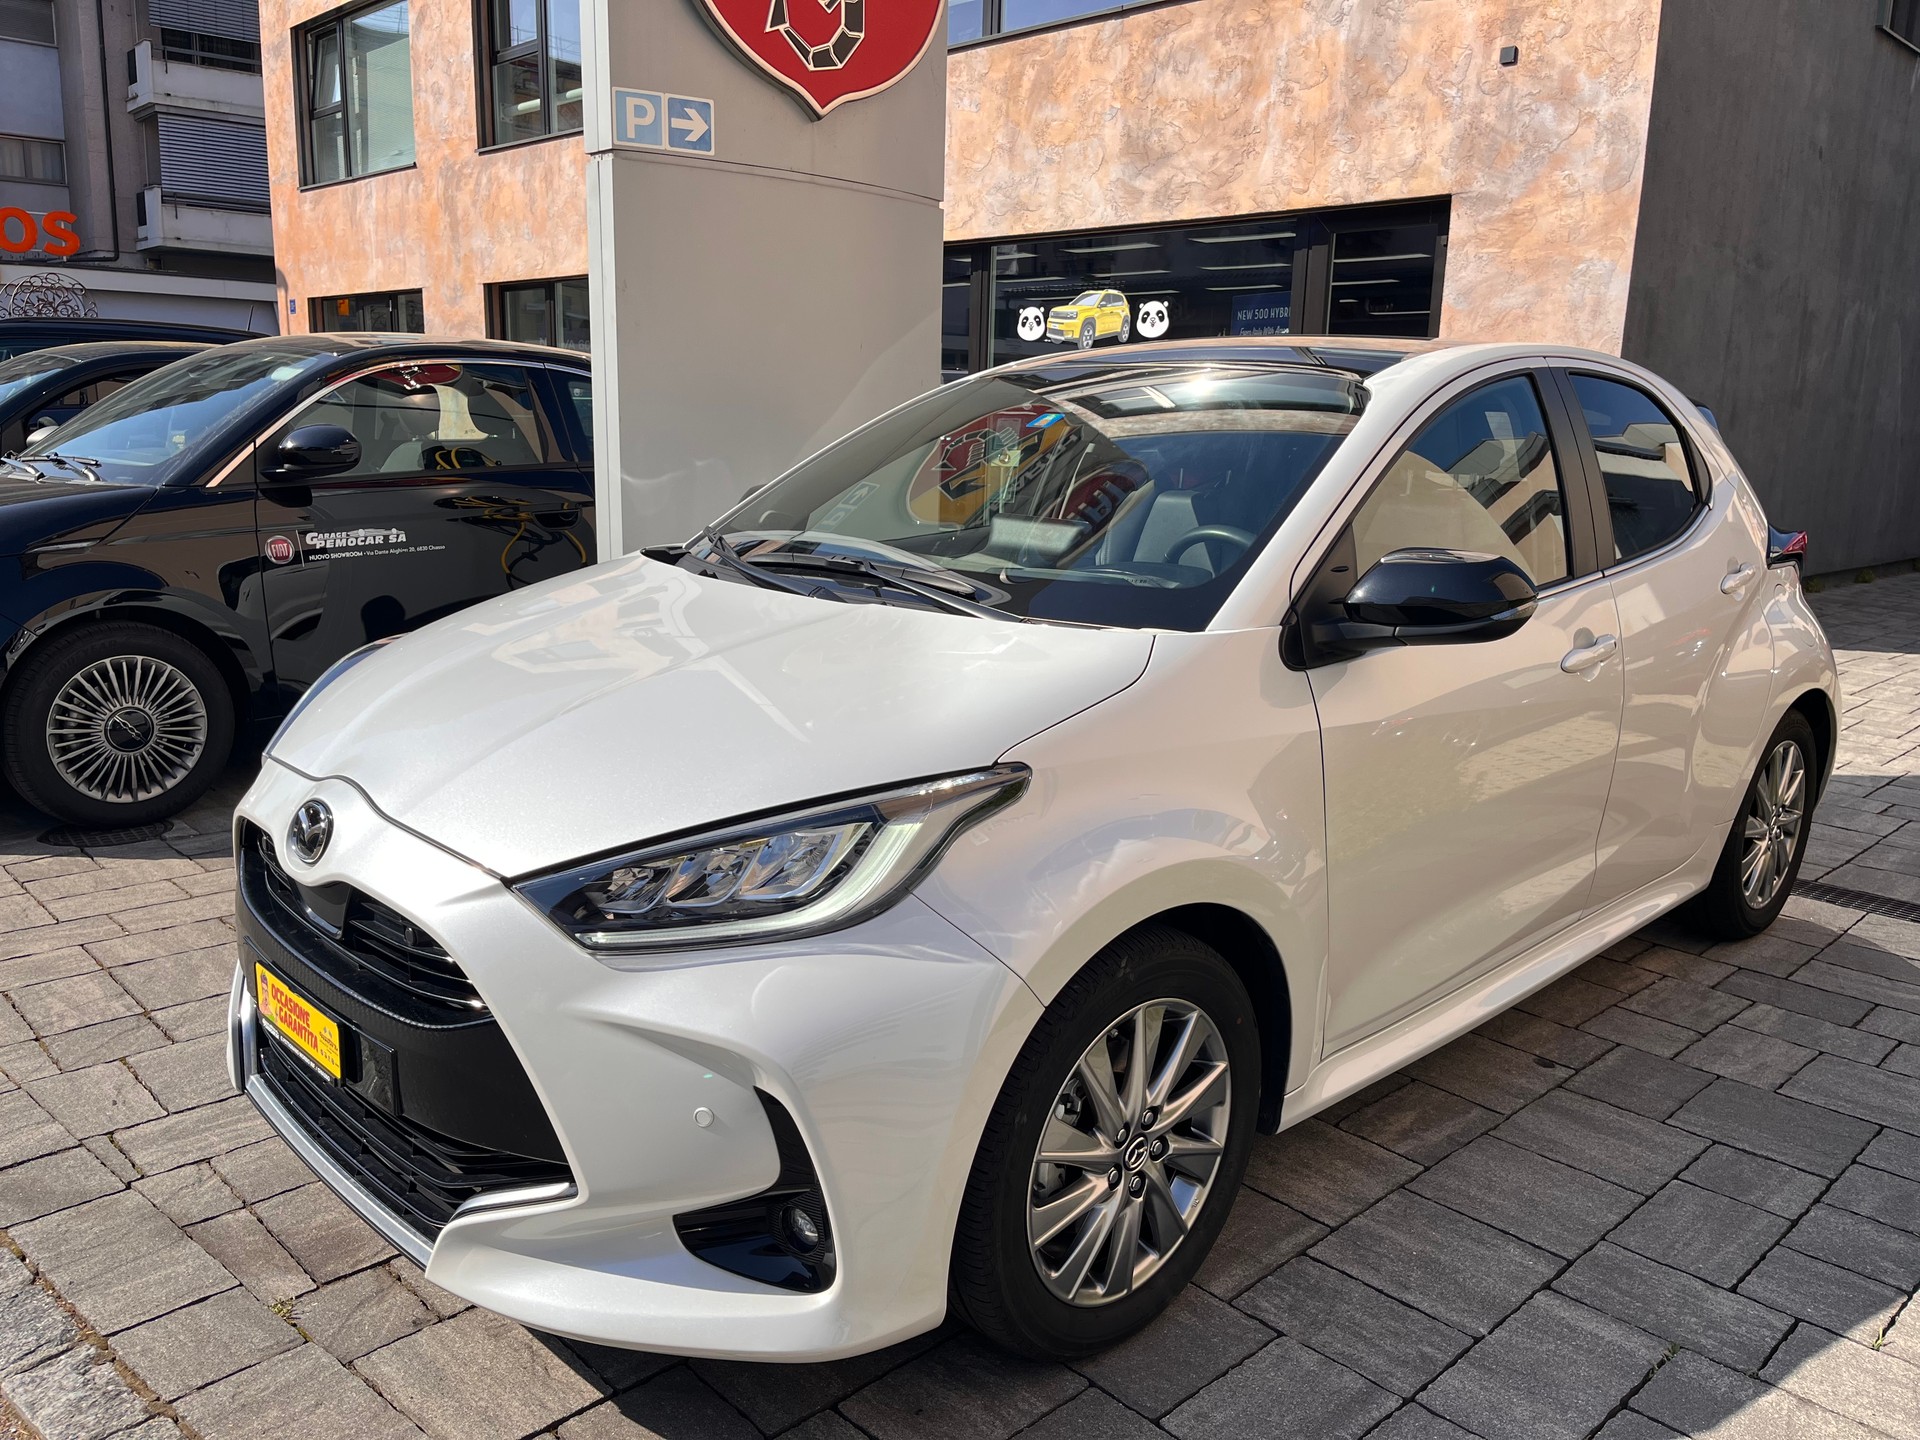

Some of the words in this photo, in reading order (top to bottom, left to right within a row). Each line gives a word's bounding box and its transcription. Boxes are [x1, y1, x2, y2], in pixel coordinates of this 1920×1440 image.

[625, 96, 656, 139] P
[1237, 309, 1253, 321] NEW
[1254, 308, 1269, 320] 500
[305, 531, 347, 545] GARAGE
[315, 535, 384, 549] PEMOCAR
[388, 533, 407, 544] SA
[271, 543, 288, 558] FIAT
[309, 553, 330, 561] NUOVO
[330, 551, 364, 560] SHOWROOM
[271, 983, 310, 1029] OCCASIONE
[279, 1006, 319, 1053] GARANTITA
